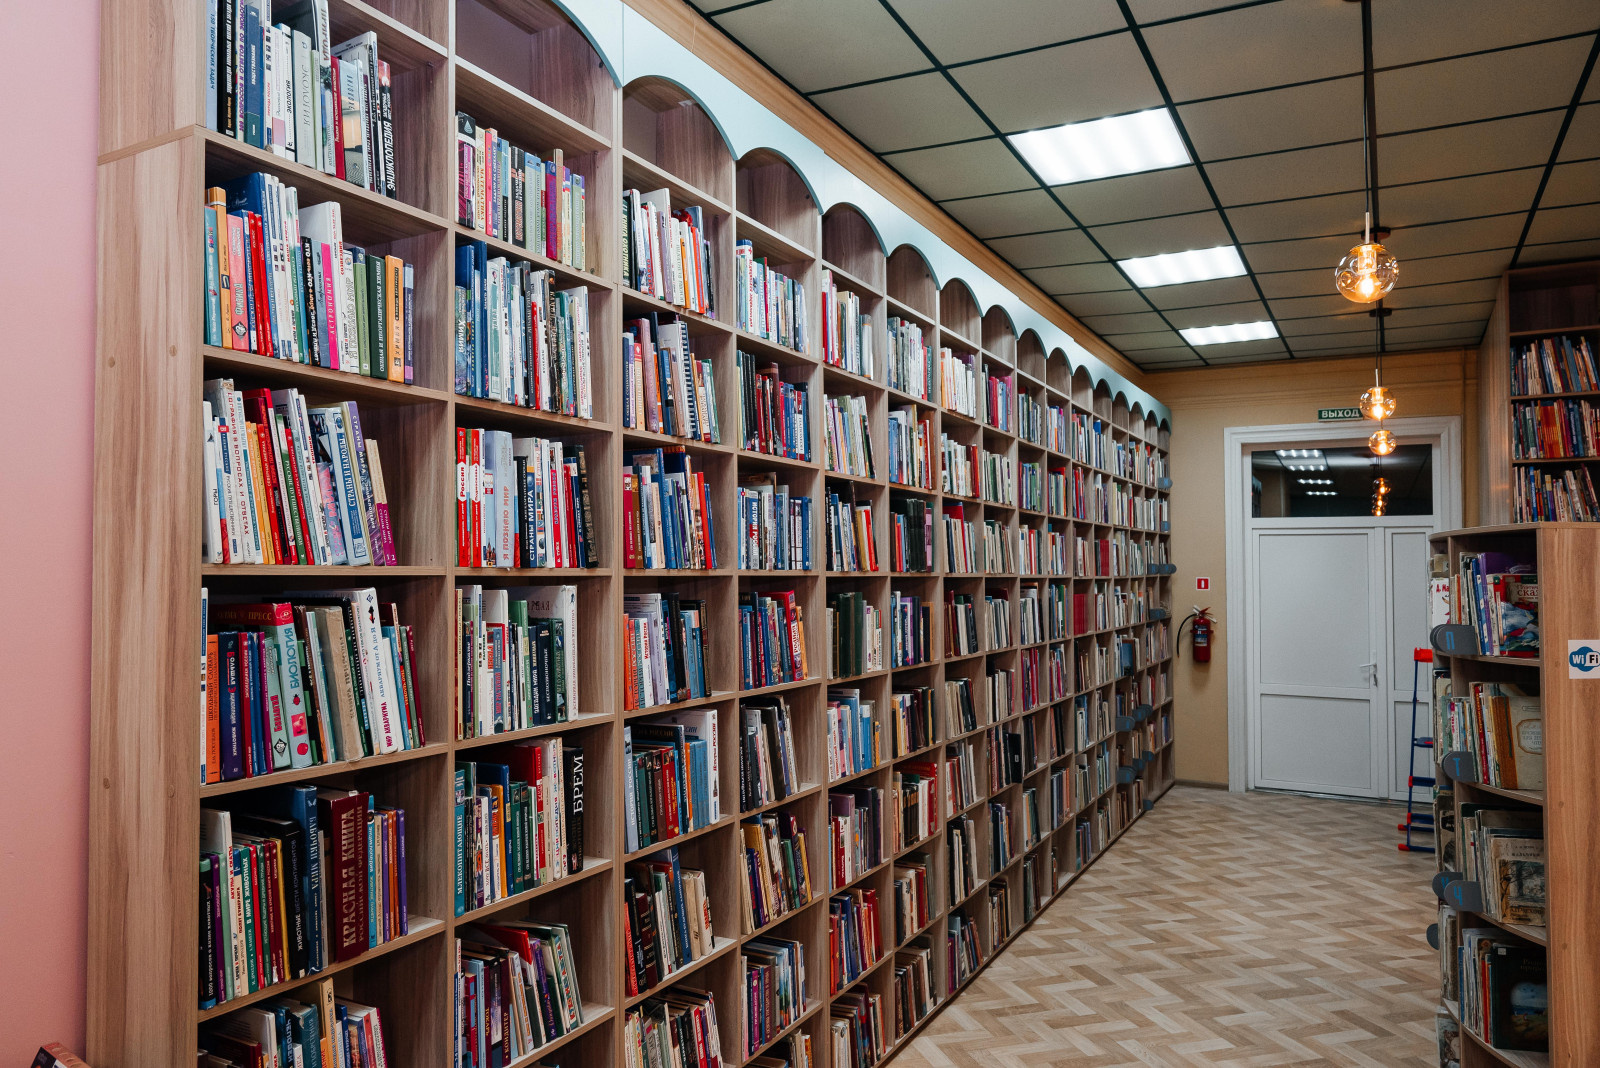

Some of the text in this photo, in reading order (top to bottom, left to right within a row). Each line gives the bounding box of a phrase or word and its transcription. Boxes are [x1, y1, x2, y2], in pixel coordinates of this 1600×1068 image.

[239, 33, 244, 42] ПО
[321, 8, 329, 61] ПРИРОДА
[301, 64, 311, 126] ЭКОЛОГИЯ
[384, 121, 395, 190] ЭНЦИКЛОПЕДИЯ
[493, 174, 496, 182] НА
[326, 277, 334, 334] АСТРОНОМИЯ
[350, 351, 357, 359] Я
[1321, 408, 1360, 418] ВЫХОД
[234, 444, 243, 488] ВОПРОСАХ
[241, 501, 249, 535] ОТВЕТАХ
[353, 415, 375, 529] СТРАНЫ МИРА ЭНЦИКЛОПЕДИЯ
[346, 478, 356, 507] СТРАНЫ
[289, 487, 303, 545] ПУТЕШЕСТВЕННИКИ
[248, 611, 272, 620] ПРЕСС
[284, 627, 300, 689] БИОЛОГИЯ
[1446, 631, 1455, 650] П
[1572, 654, 1599, 664] Wi Fi
[227, 652, 236, 685] БОЛЬШАЯ
[376, 661, 385, 697] АКВАРИУМ
[381, 702, 391, 733] АКВАРИУМА
[385, 735, 393, 747] МИР
[573, 754, 584, 815] БРЕМ
[1453, 757, 1460, 776] Т
[291, 840, 299, 888] КОНТИНЕНТОВ
[309, 817, 319, 889] БАБОЧКИ МИРА
[341, 809, 356, 947] КРАСНАЯ КНИГА
[355, 805, 364, 941] РОССИЙСКОЙ ФЕДЕРАЦИИ
[295, 914, 303, 951] ЖИВОТНЫЕ
